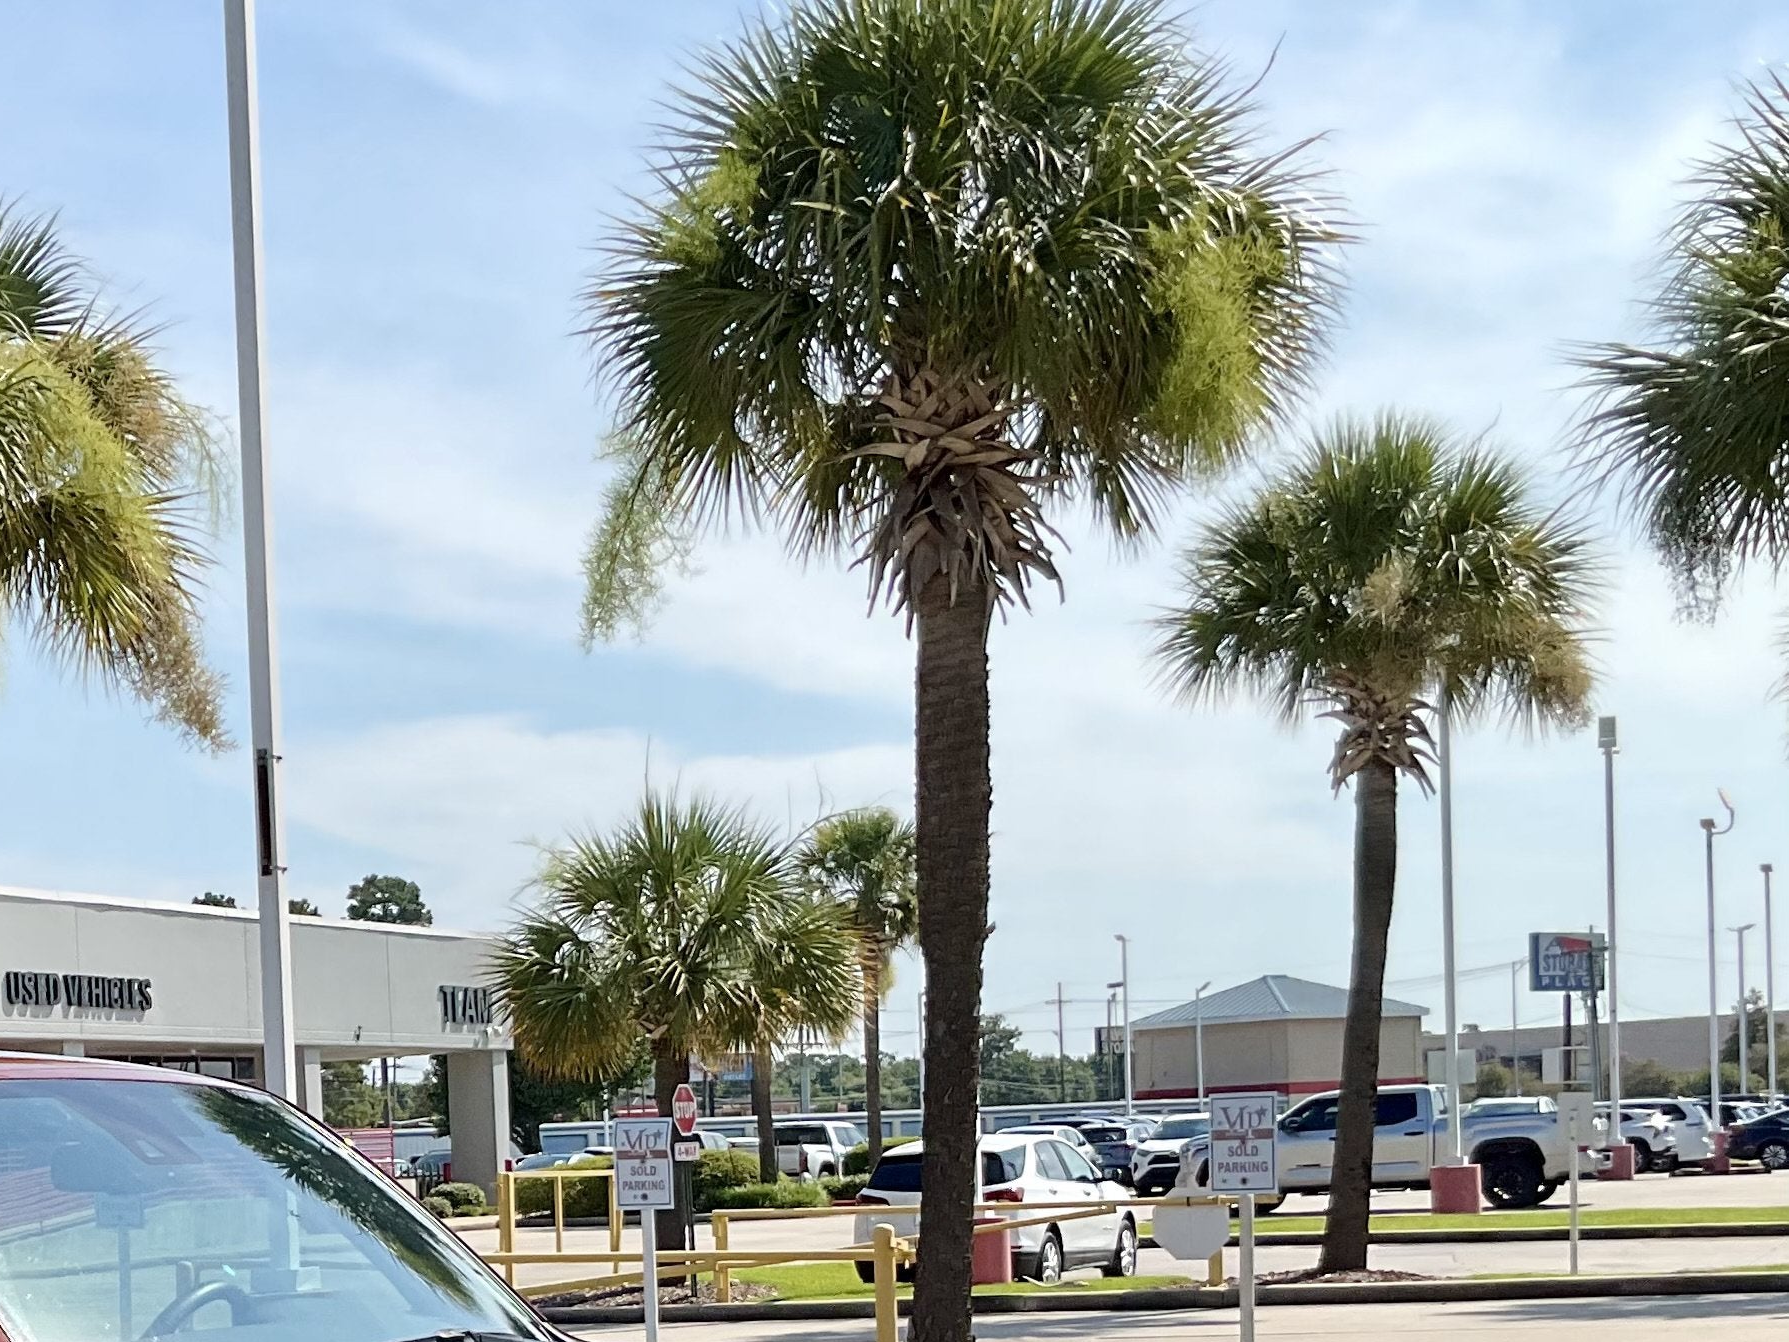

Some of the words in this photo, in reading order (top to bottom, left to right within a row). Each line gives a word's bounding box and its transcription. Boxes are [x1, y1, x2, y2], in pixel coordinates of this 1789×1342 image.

[5, 971, 61, 1005] USED
[62, 975, 153, 1011] VEHICLES
[675, 1101, 695, 1119] STOP
[1227, 1145, 1259, 1157] SOLD
[629, 1165, 657, 1176] SOLD
[1217, 1161, 1269, 1173] PARKING
[622, 1180, 666, 1191] PARKING
